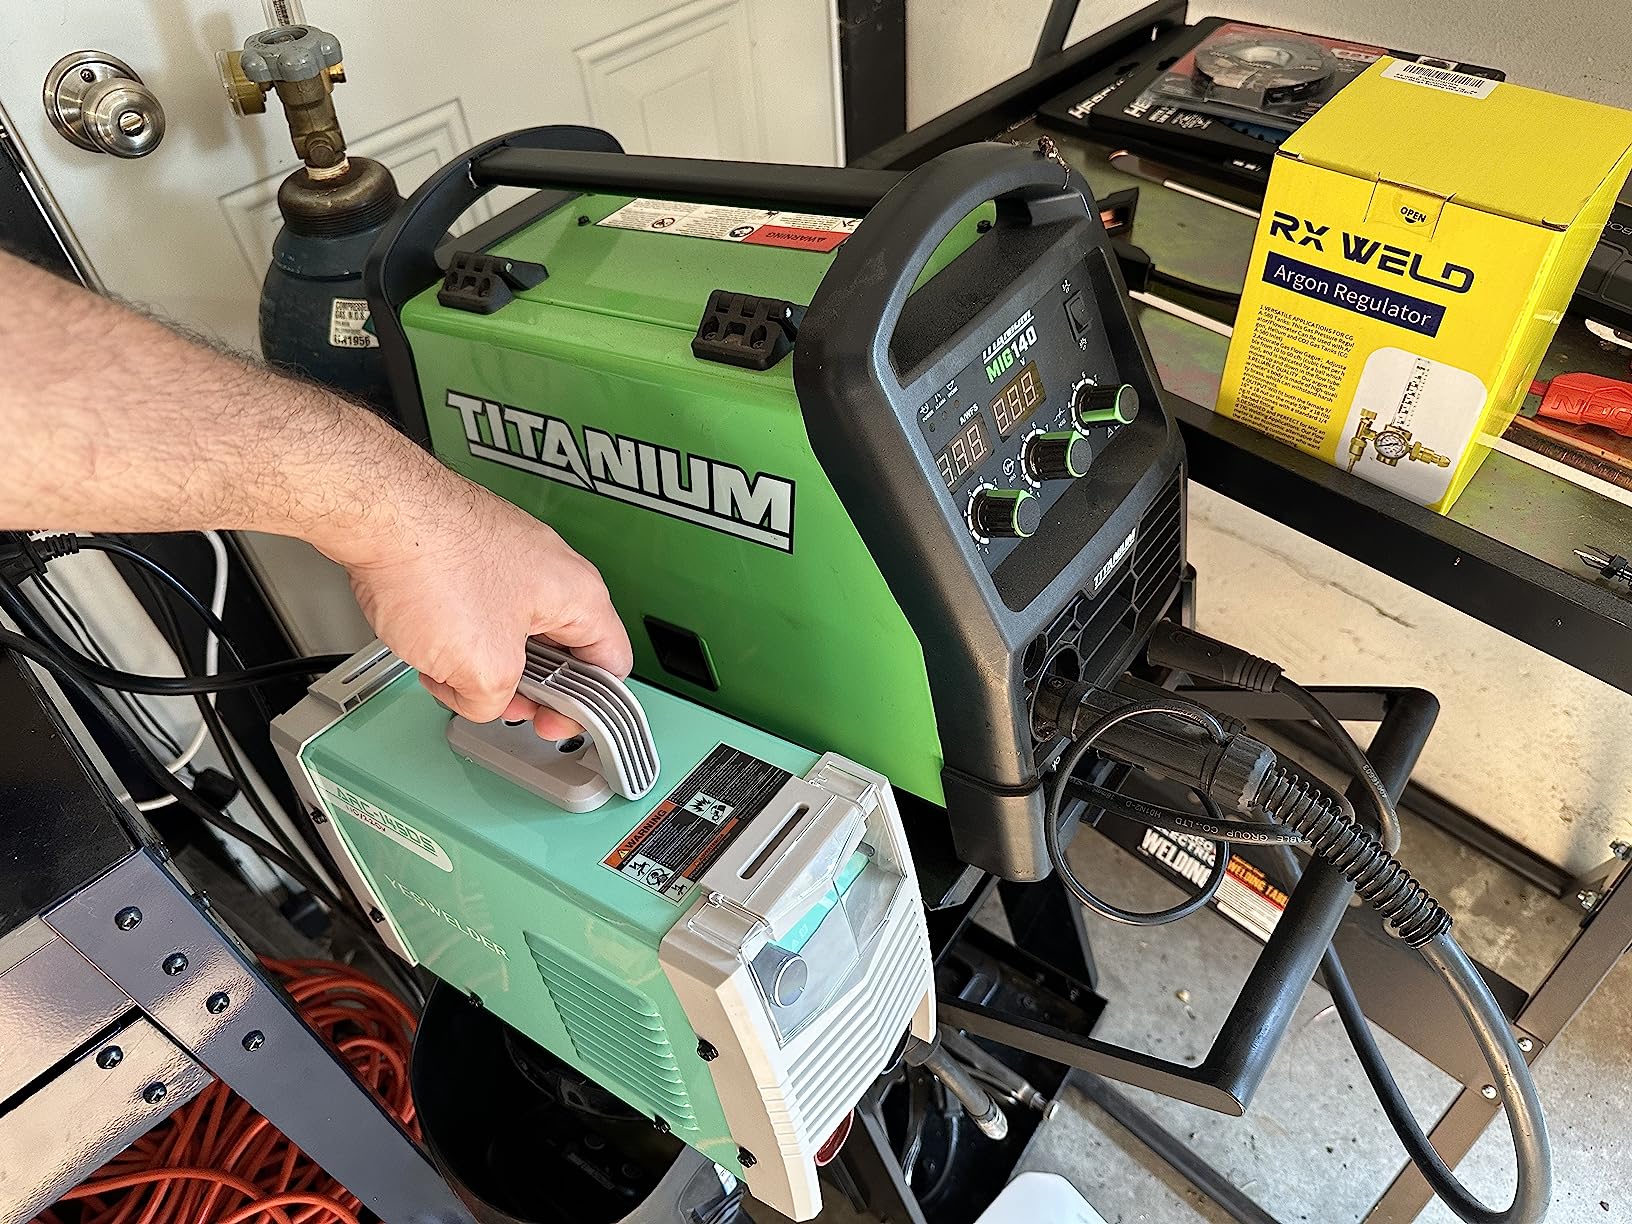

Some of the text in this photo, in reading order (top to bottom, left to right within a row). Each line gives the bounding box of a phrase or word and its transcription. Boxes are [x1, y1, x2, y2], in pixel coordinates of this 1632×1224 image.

[1400, 206, 1427, 223] OPEN
[1270, 210, 1475, 294] RX WELD
[1273, 263, 1432, 326] Argon Regulator
[446, 389, 795, 550] TITANIUM
[626, 809, 667, 849] WARNING
[1226, 831, 1269, 842] GROUP
[384, 873, 511, 961] YESWELDER
